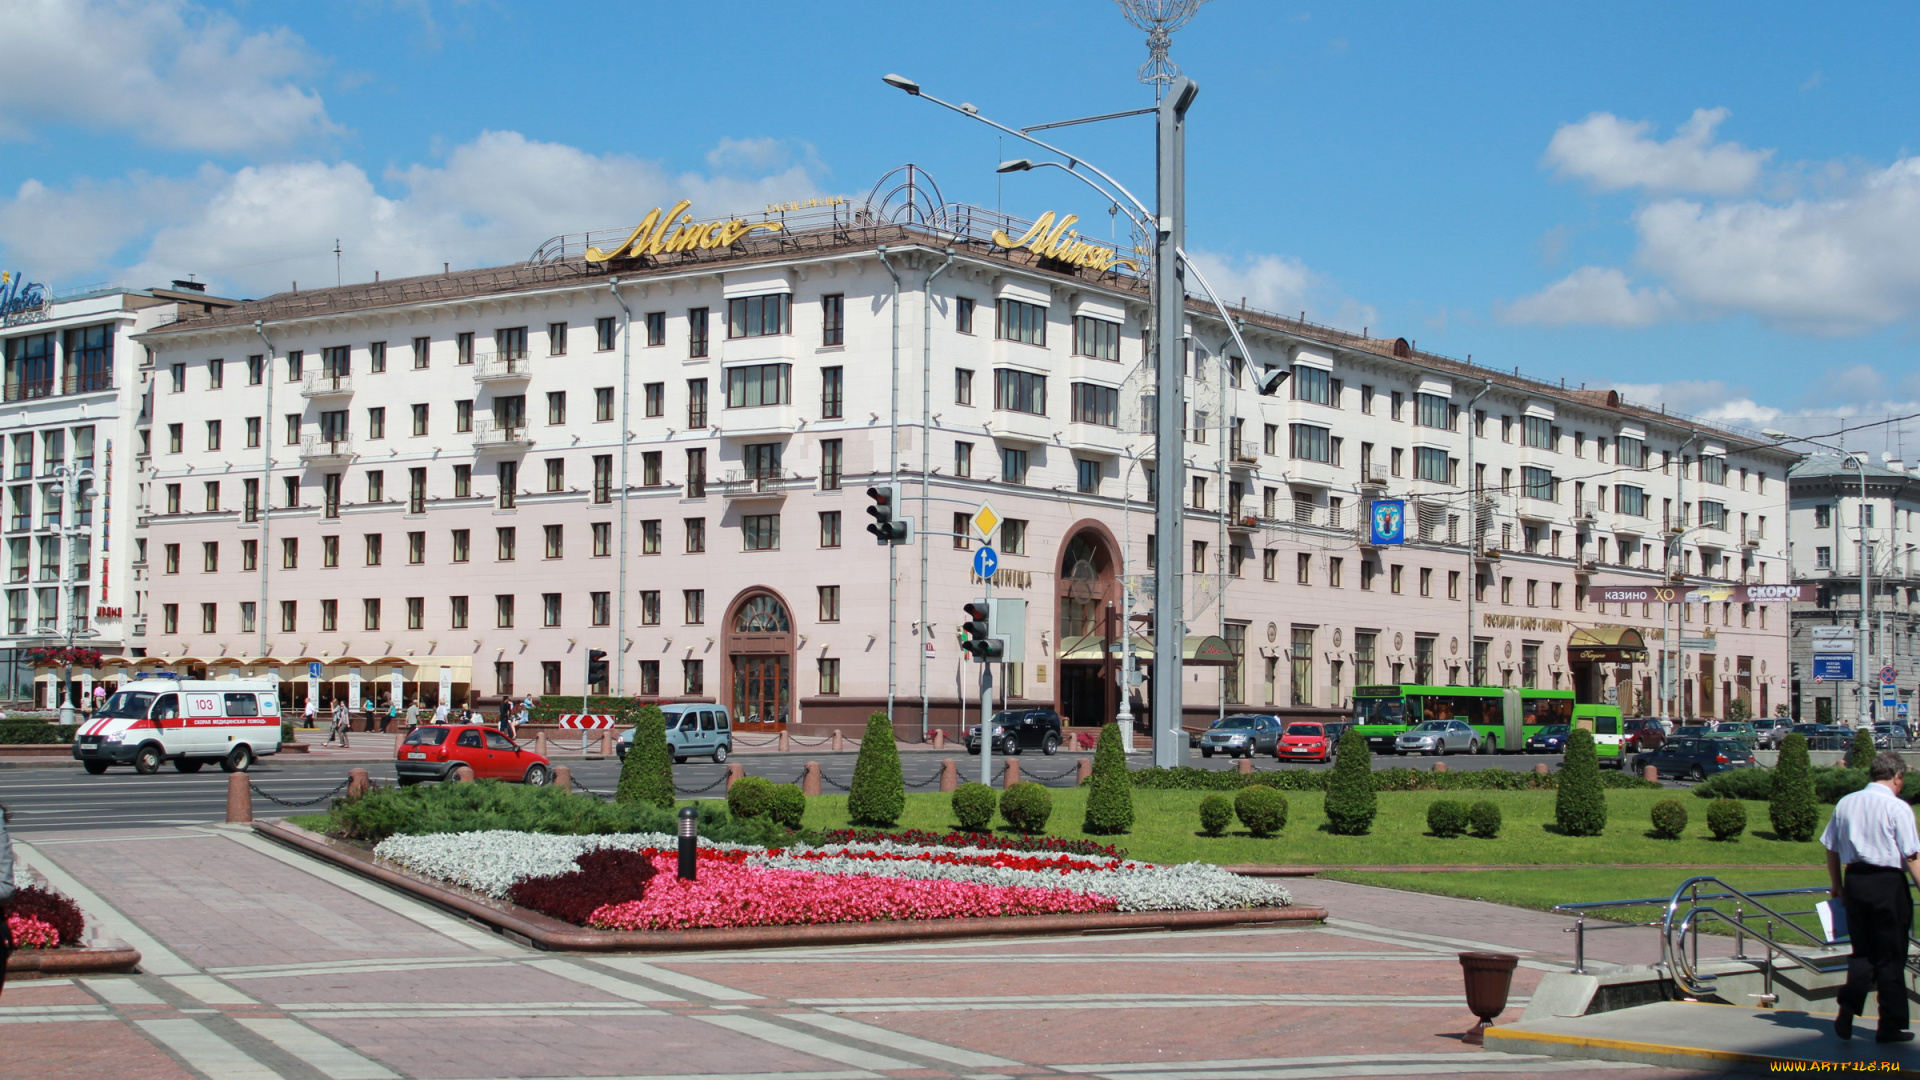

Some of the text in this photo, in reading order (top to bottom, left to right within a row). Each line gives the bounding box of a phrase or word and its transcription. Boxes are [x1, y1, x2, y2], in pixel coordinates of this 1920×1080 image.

[991, 211, 1139, 273] Minsk
[1604, 590, 1647, 600] казино
[1746, 586, 1801, 598] СКОРО!
[195, 699, 213, 710] 103
